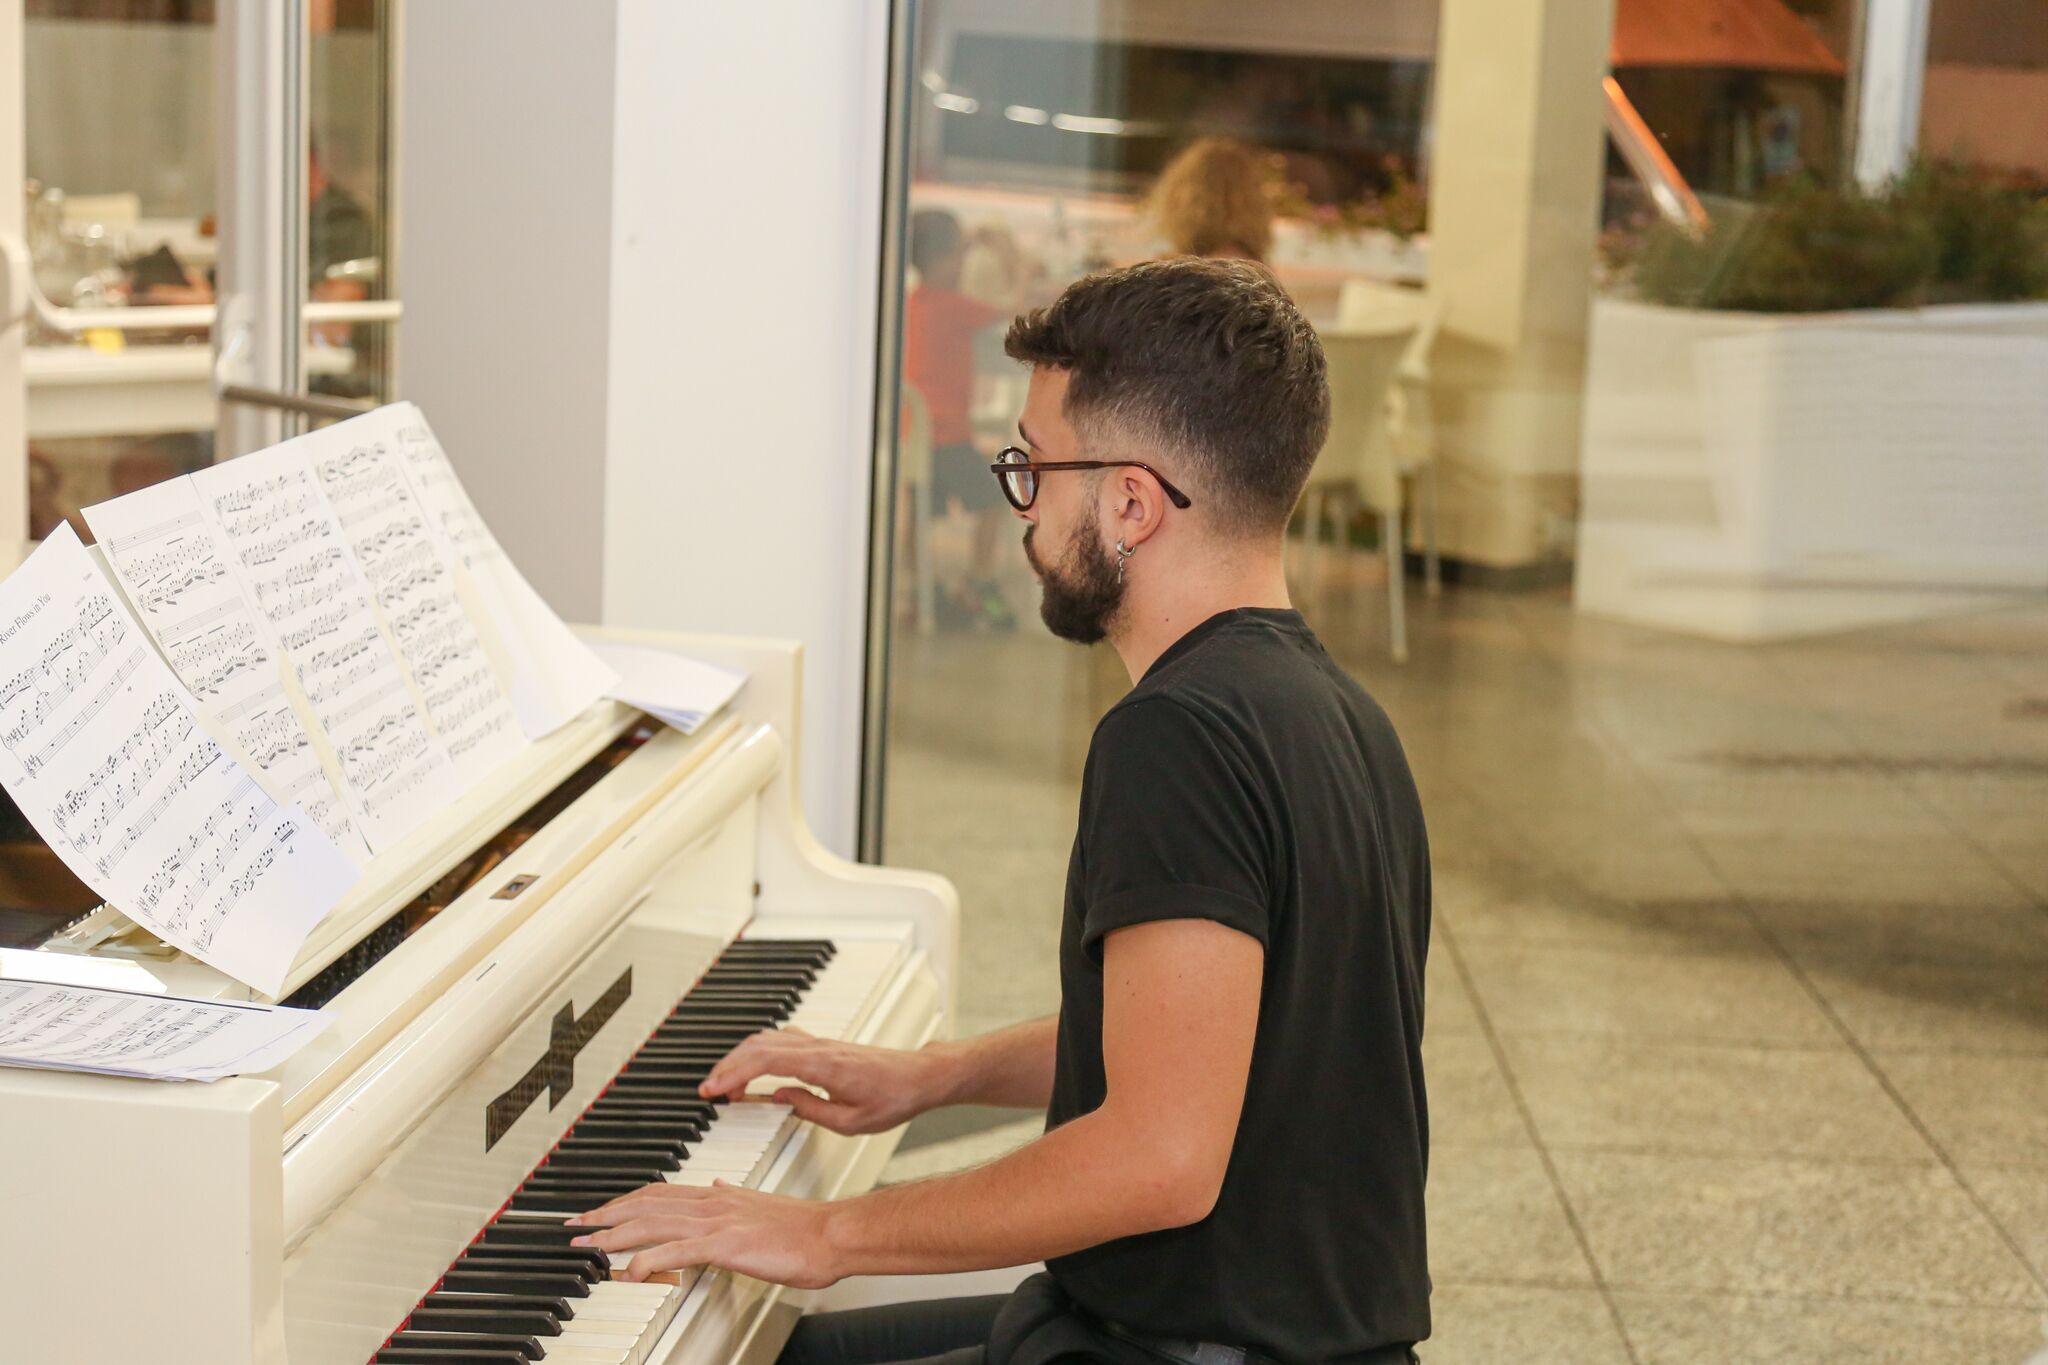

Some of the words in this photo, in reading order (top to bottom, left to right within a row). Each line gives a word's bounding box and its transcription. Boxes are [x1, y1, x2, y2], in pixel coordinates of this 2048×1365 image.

[0, 625, 17, 645] River
[14, 610, 35, 629] Flows
[32, 603, 42, 614] in
[37, 593, 51, 606] You
